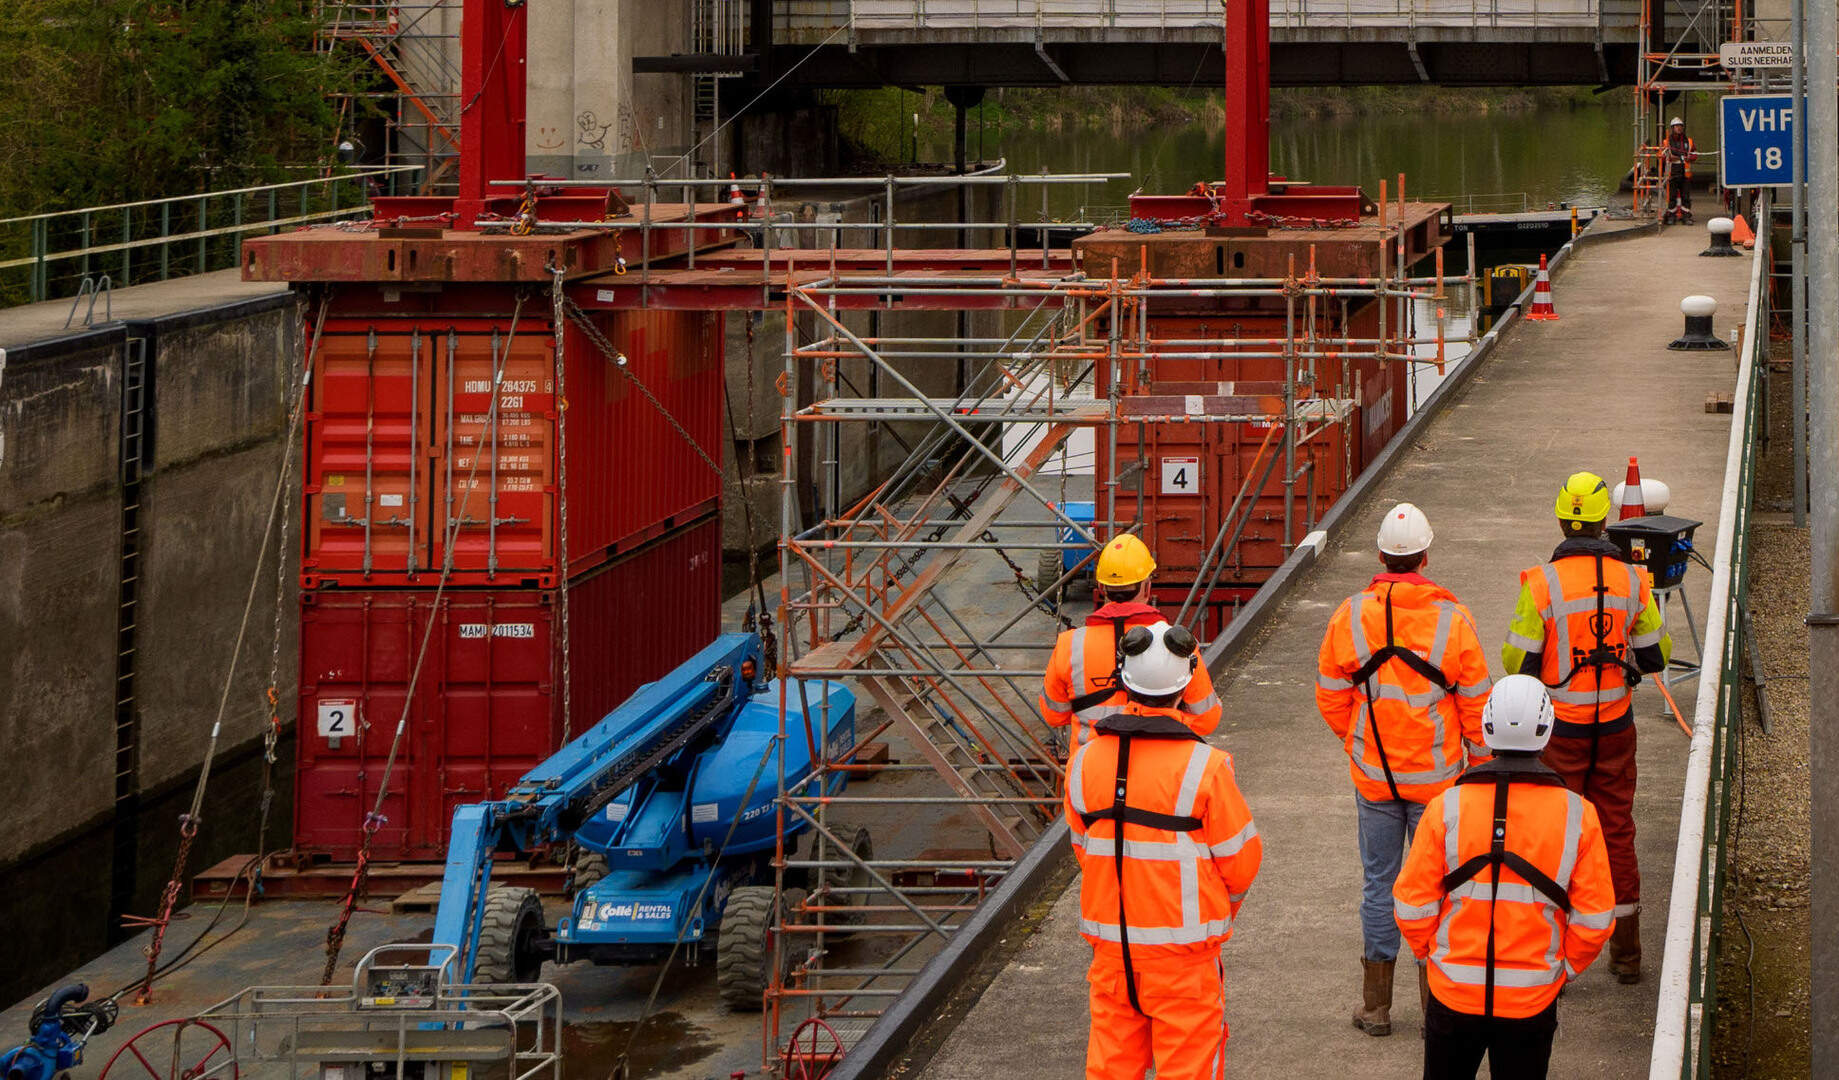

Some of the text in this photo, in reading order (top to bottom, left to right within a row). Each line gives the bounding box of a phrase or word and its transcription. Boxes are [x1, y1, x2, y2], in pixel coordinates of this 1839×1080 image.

[1740, 46, 1793, 54] AANMELDEN
[1728, 57, 1752, 65] SLUIS
[1739, 108, 1793, 131] VHF
[1754, 146, 1782, 170] 18
[465, 380, 491, 393] HDMU
[501, 396, 524, 409] 2261
[1173, 468, 1188, 489] 4
[492, 625, 531, 636] 2011534
[329, 710, 344, 732] 2
[744, 809, 761, 820] 220
